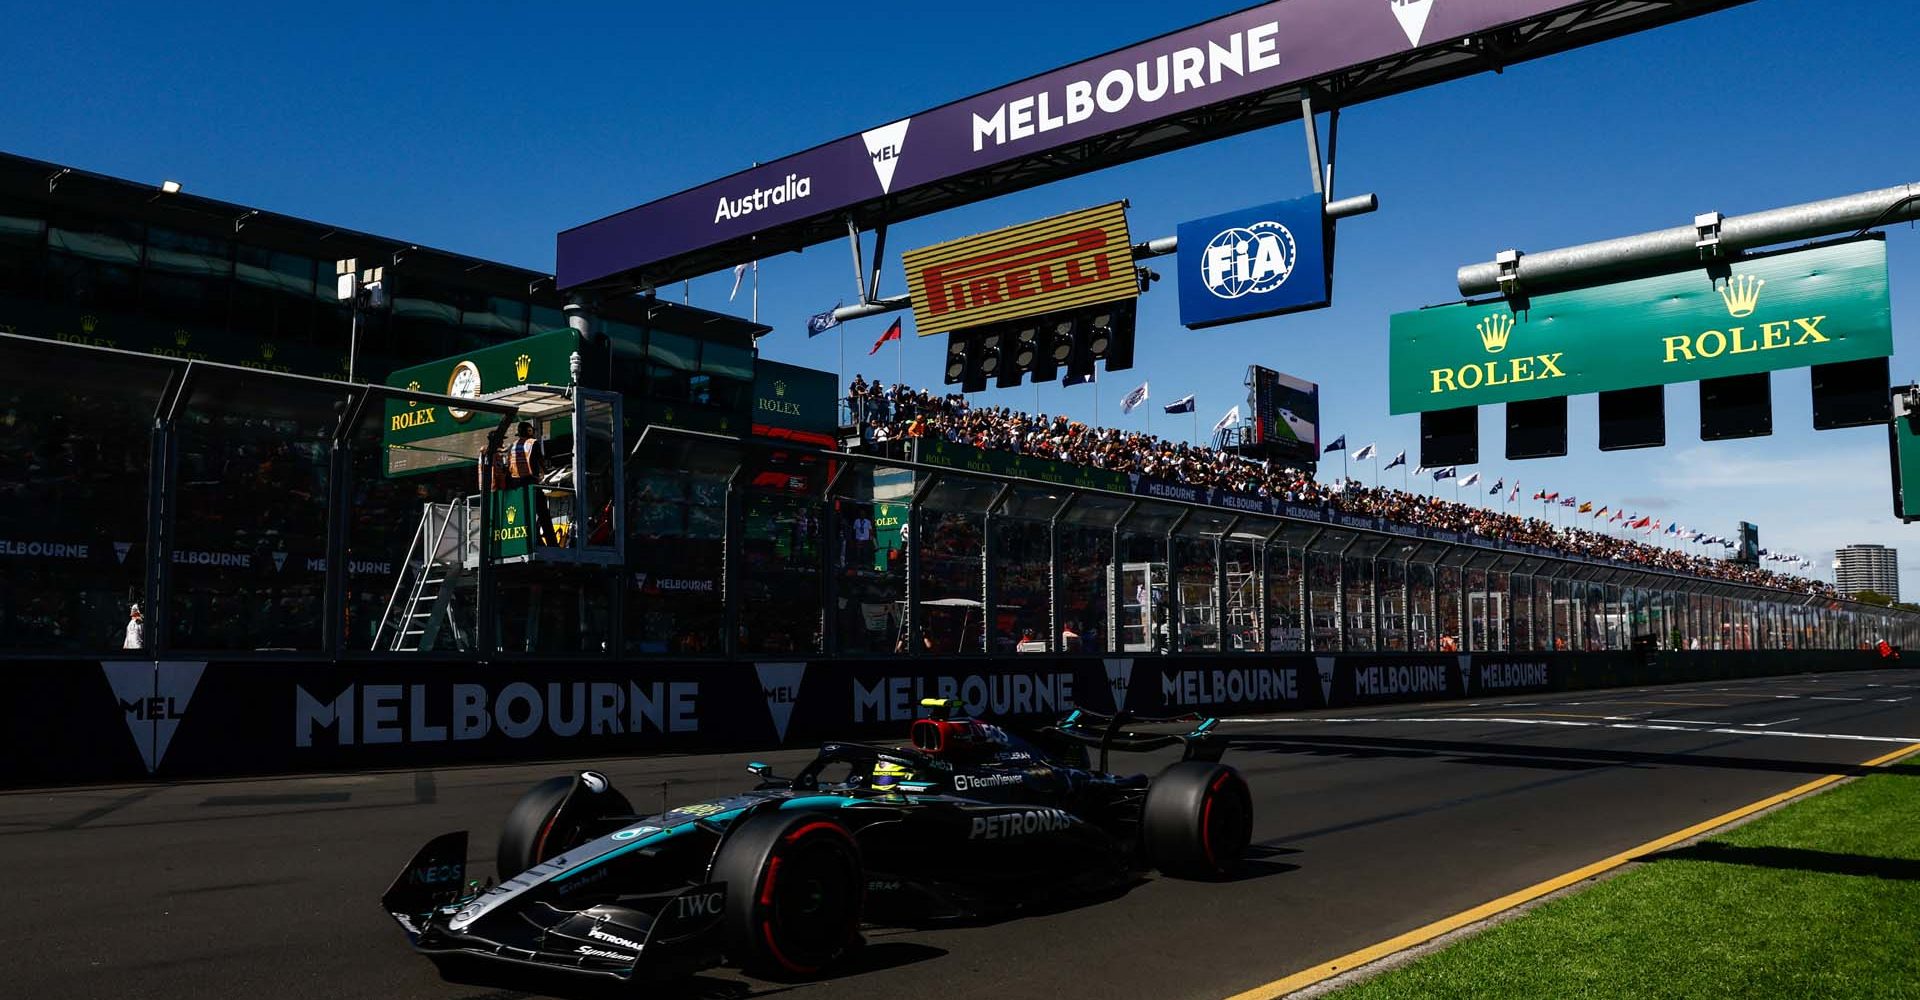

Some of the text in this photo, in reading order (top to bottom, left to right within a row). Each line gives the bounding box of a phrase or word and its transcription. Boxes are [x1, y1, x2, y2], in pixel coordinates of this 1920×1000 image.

[972, 20, 1281, 153] MELBOURNE
[870, 144, 901, 164] MEL
[714, 173, 812, 224] Australia
[921, 228, 1110, 315] PIRELLI
[1661, 315, 1831, 364] ROLEX
[1429, 351, 1567, 394] ROLEX
[391, 407, 435, 431] ROLEX
[759, 398, 801, 416] ROLEX
[1149, 483, 1198, 501] MELBOURNE
[1222, 495, 1264, 513] MELBOURNE
[1286, 505, 1321, 521] MELBOURNE
[494, 525, 529, 541] ROLEX
[0, 540, 89, 559] ELBOURNE
[171, 550, 251, 568] ELBOURNE
[656, 577, 713, 592] MELBOURNE
[1161, 667, 1298, 706] MELBOURNE
[1354, 663, 1447, 696] MELBOURNE
[1480, 661, 1549, 690] MELBOURNE
[763, 686, 797, 702] MEL
[853, 672, 1074, 723] MELBOURNE
[119, 697, 184, 721] MEL
[295, 679, 700, 749] MELBOURNE
[967, 774, 1022, 789] TeamViewer
[967, 808, 1071, 840] PETRONAS
[409, 864, 462, 885] INEOS
[677, 893, 723, 919] IWC
[588, 928, 645, 951] PETRONAS
